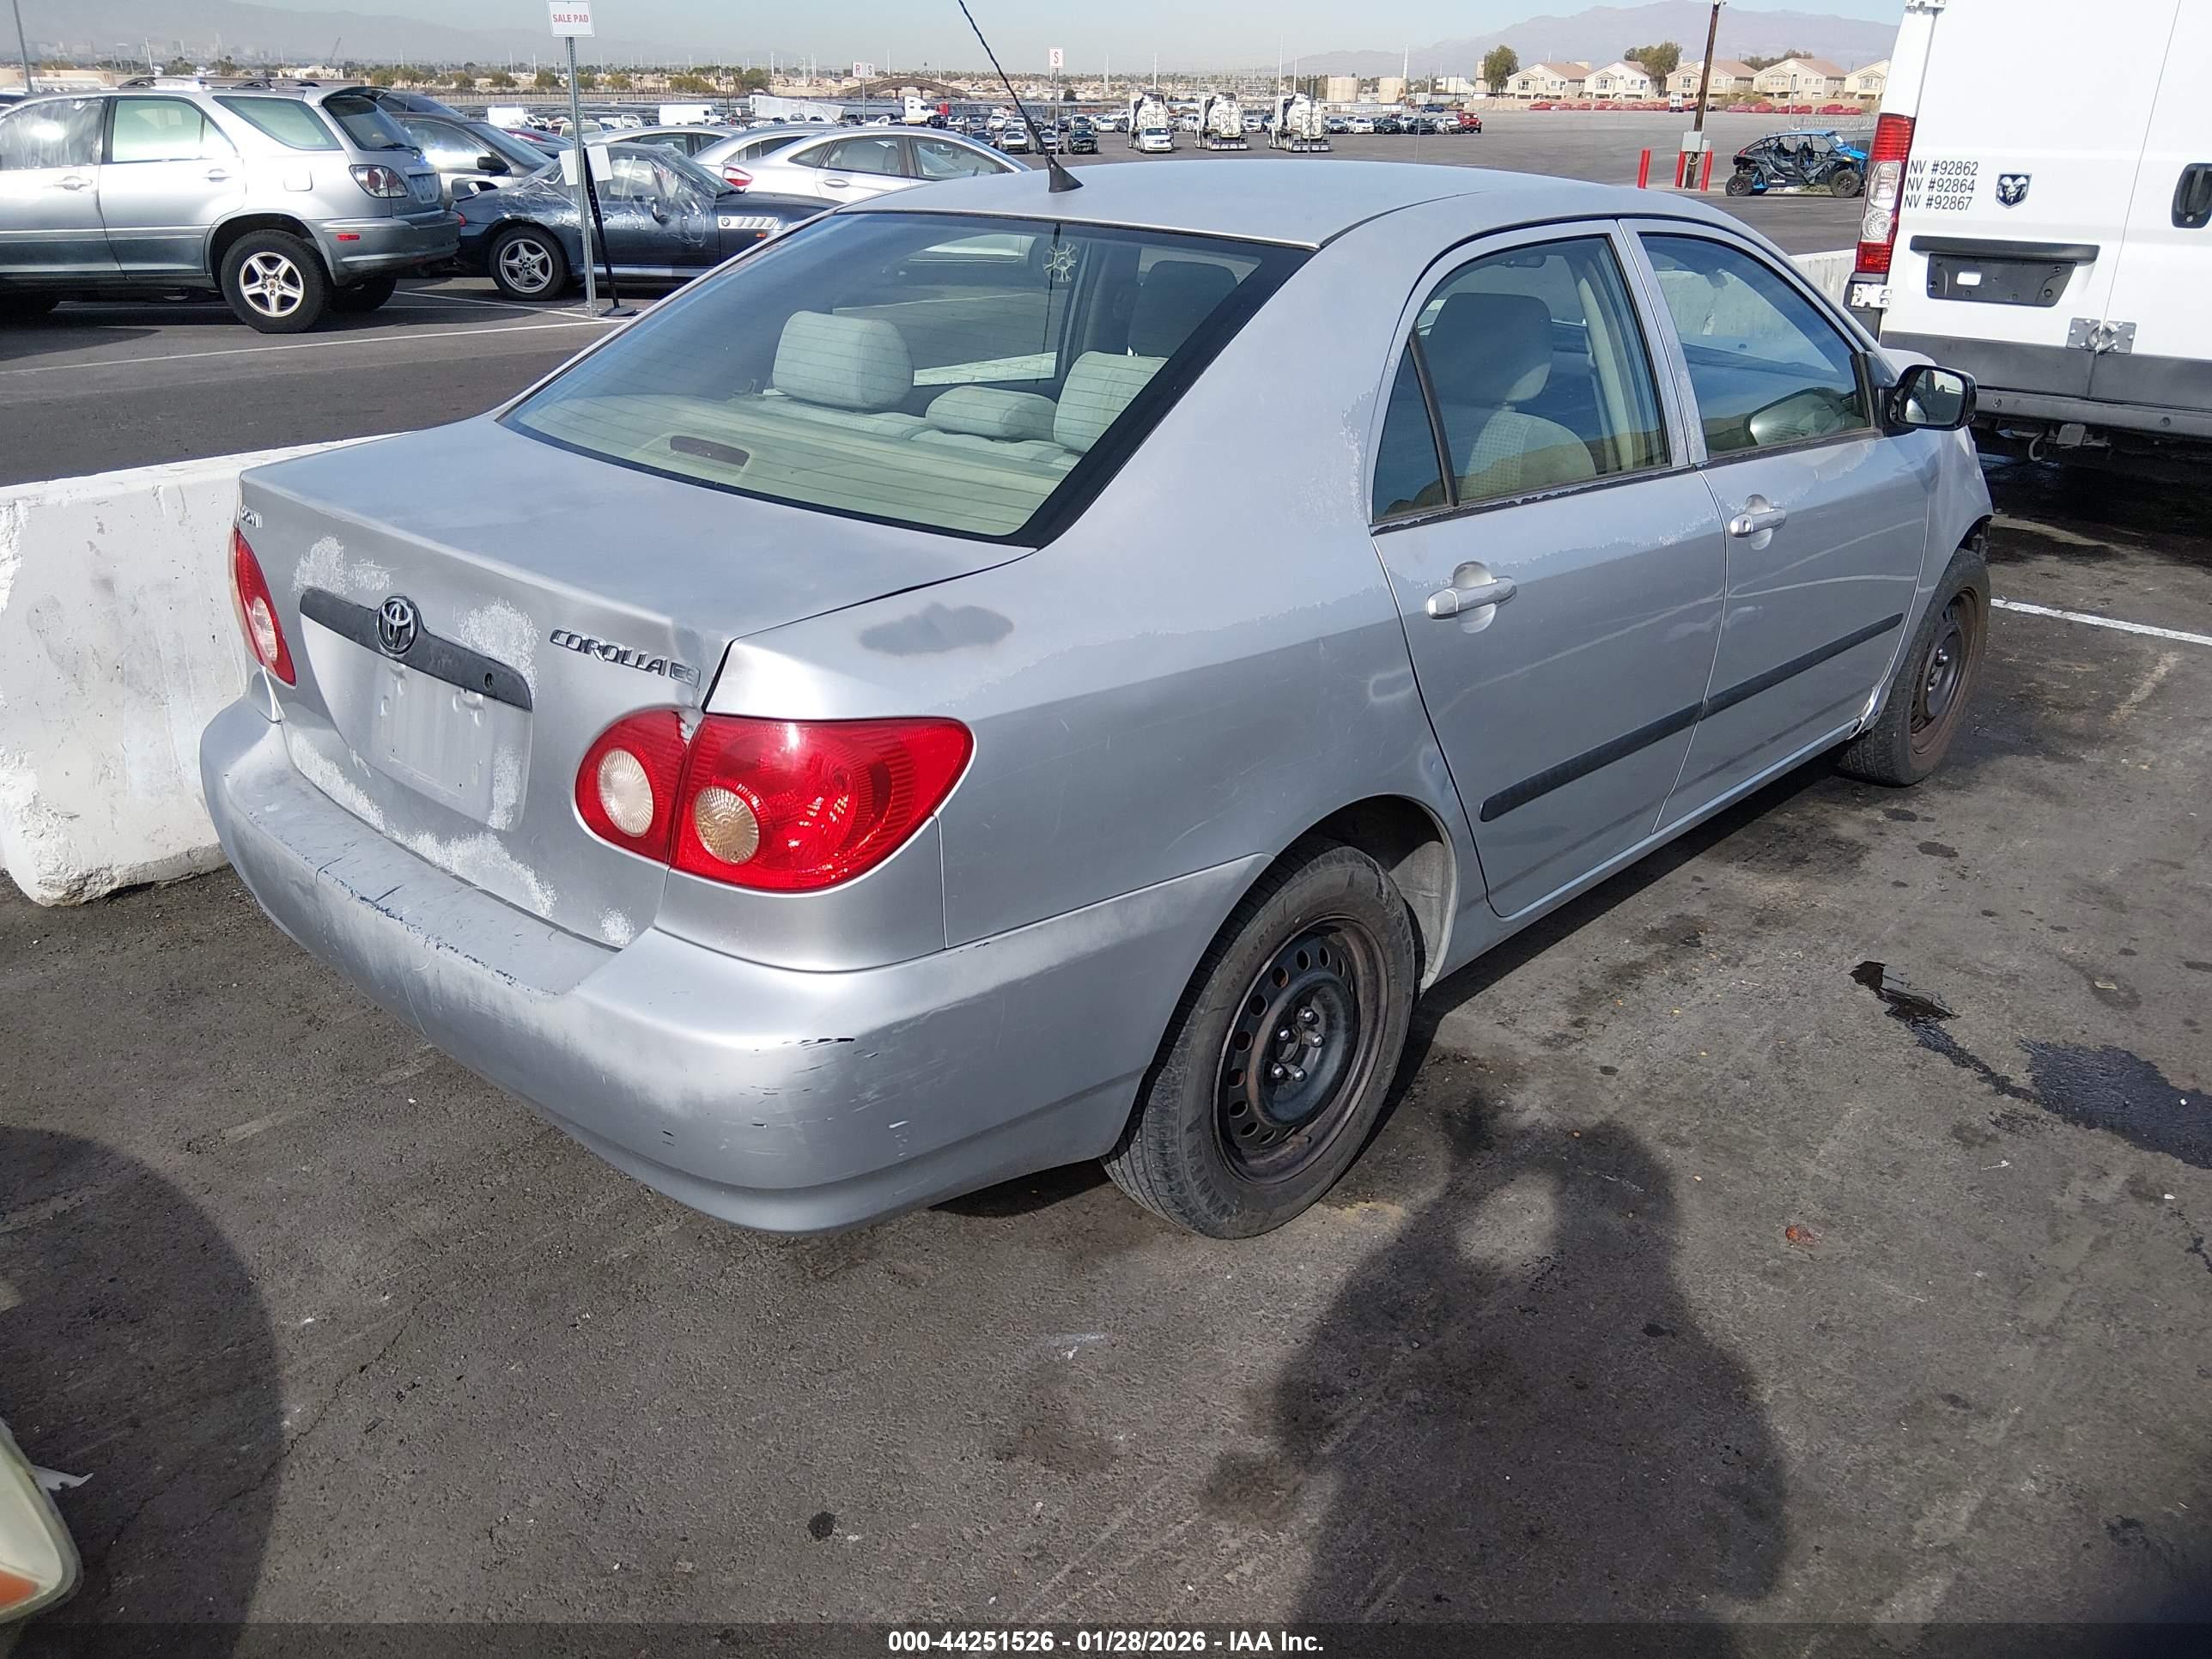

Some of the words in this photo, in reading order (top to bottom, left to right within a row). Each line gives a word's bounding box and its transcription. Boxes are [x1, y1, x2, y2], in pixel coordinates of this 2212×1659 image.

[552, 14, 572, 23] SALE
[573, 14, 589, 23] PAD
[1054, 51, 1059, 64] S
[855, 64, 861, 76] R
[867, 64, 872, 76] S
[1909, 160, 1927, 174] NV
[1930, 160, 1978, 176] #92862
[1905, 177, 1923, 191] NV
[1927, 177, 1975, 193] #92864
[1904, 194, 1921, 209] NV
[1925, 194, 1972, 211] #92867
[550, 628, 667, 677] COROLLA
